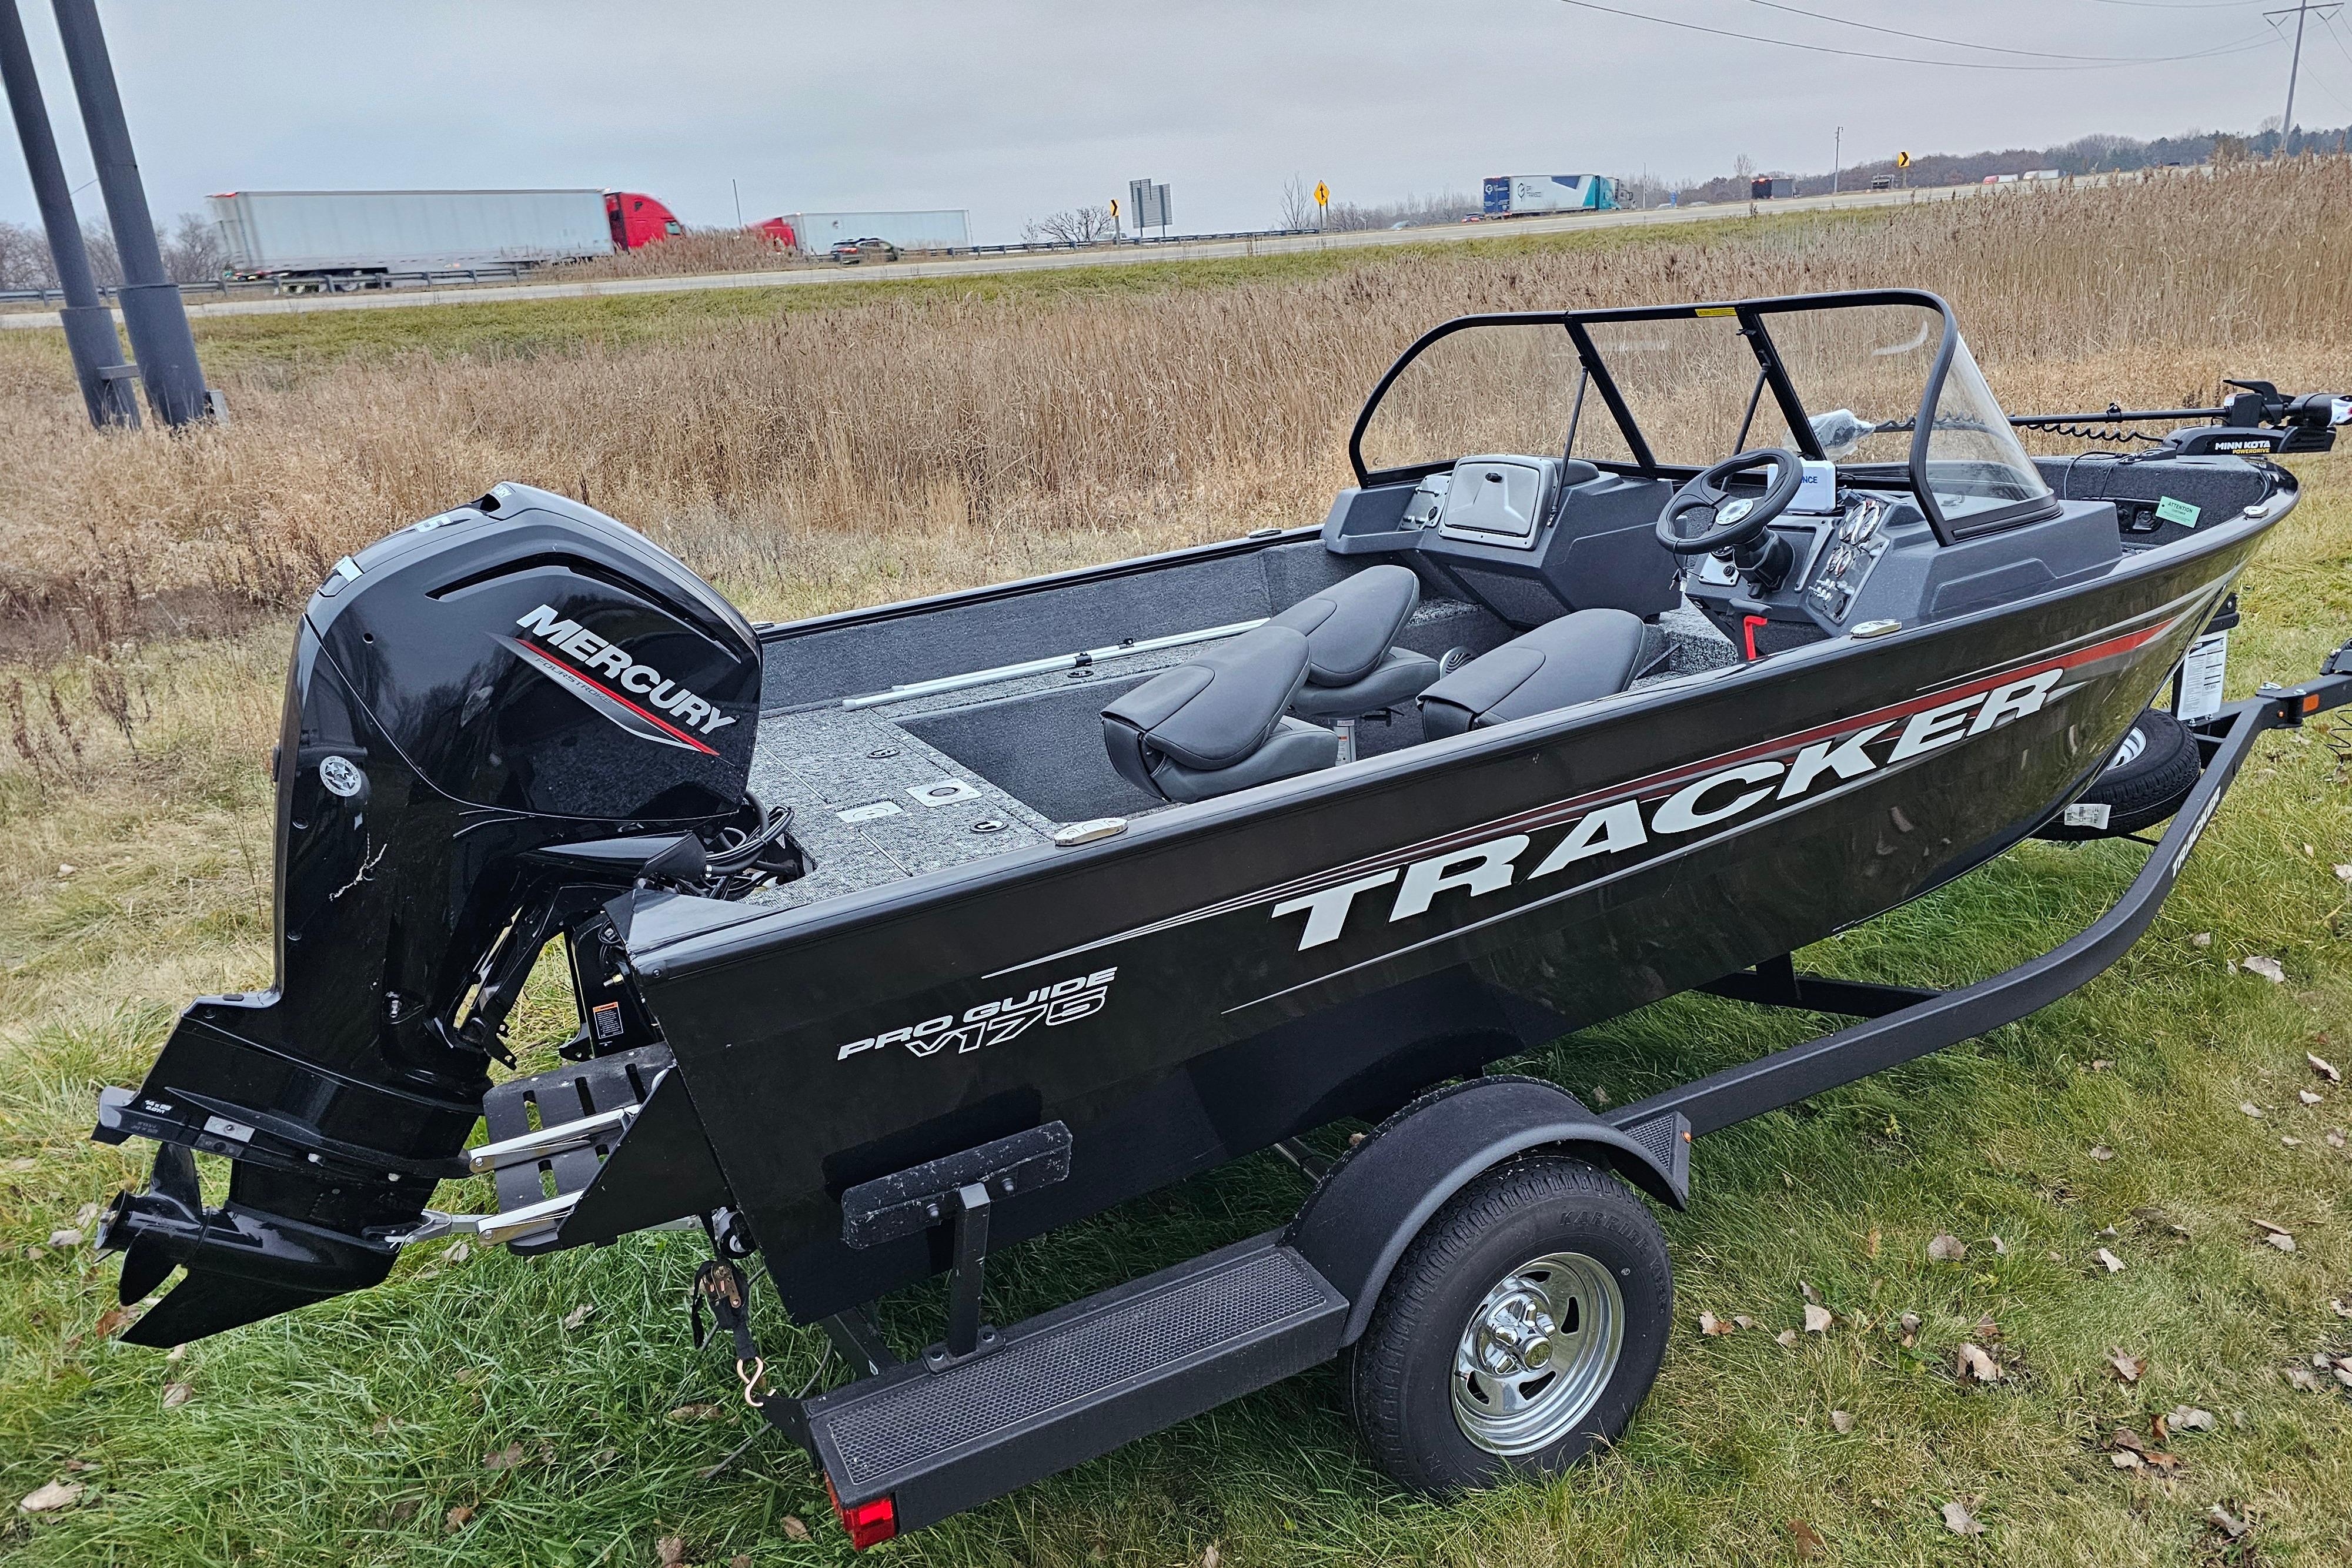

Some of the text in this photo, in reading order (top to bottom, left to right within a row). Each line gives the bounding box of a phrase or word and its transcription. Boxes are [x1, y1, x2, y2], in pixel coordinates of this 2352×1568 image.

[2215, 440, 2270, 450] MINN KOTA
[2168, 502, 2193, 513] ATTENTION
[516, 604, 736, 734] MERCURY
[535, 657, 613, 704] FOURSTROKE
[1272, 668, 2064, 951] TRACKER
[2172, 785, 2221, 878] TRACKER
[837, 967, 1118, 1060] PRO GUIDE
[904, 985, 1108, 1058] V175
[1559, 1210, 1648, 1255] KARRIER
